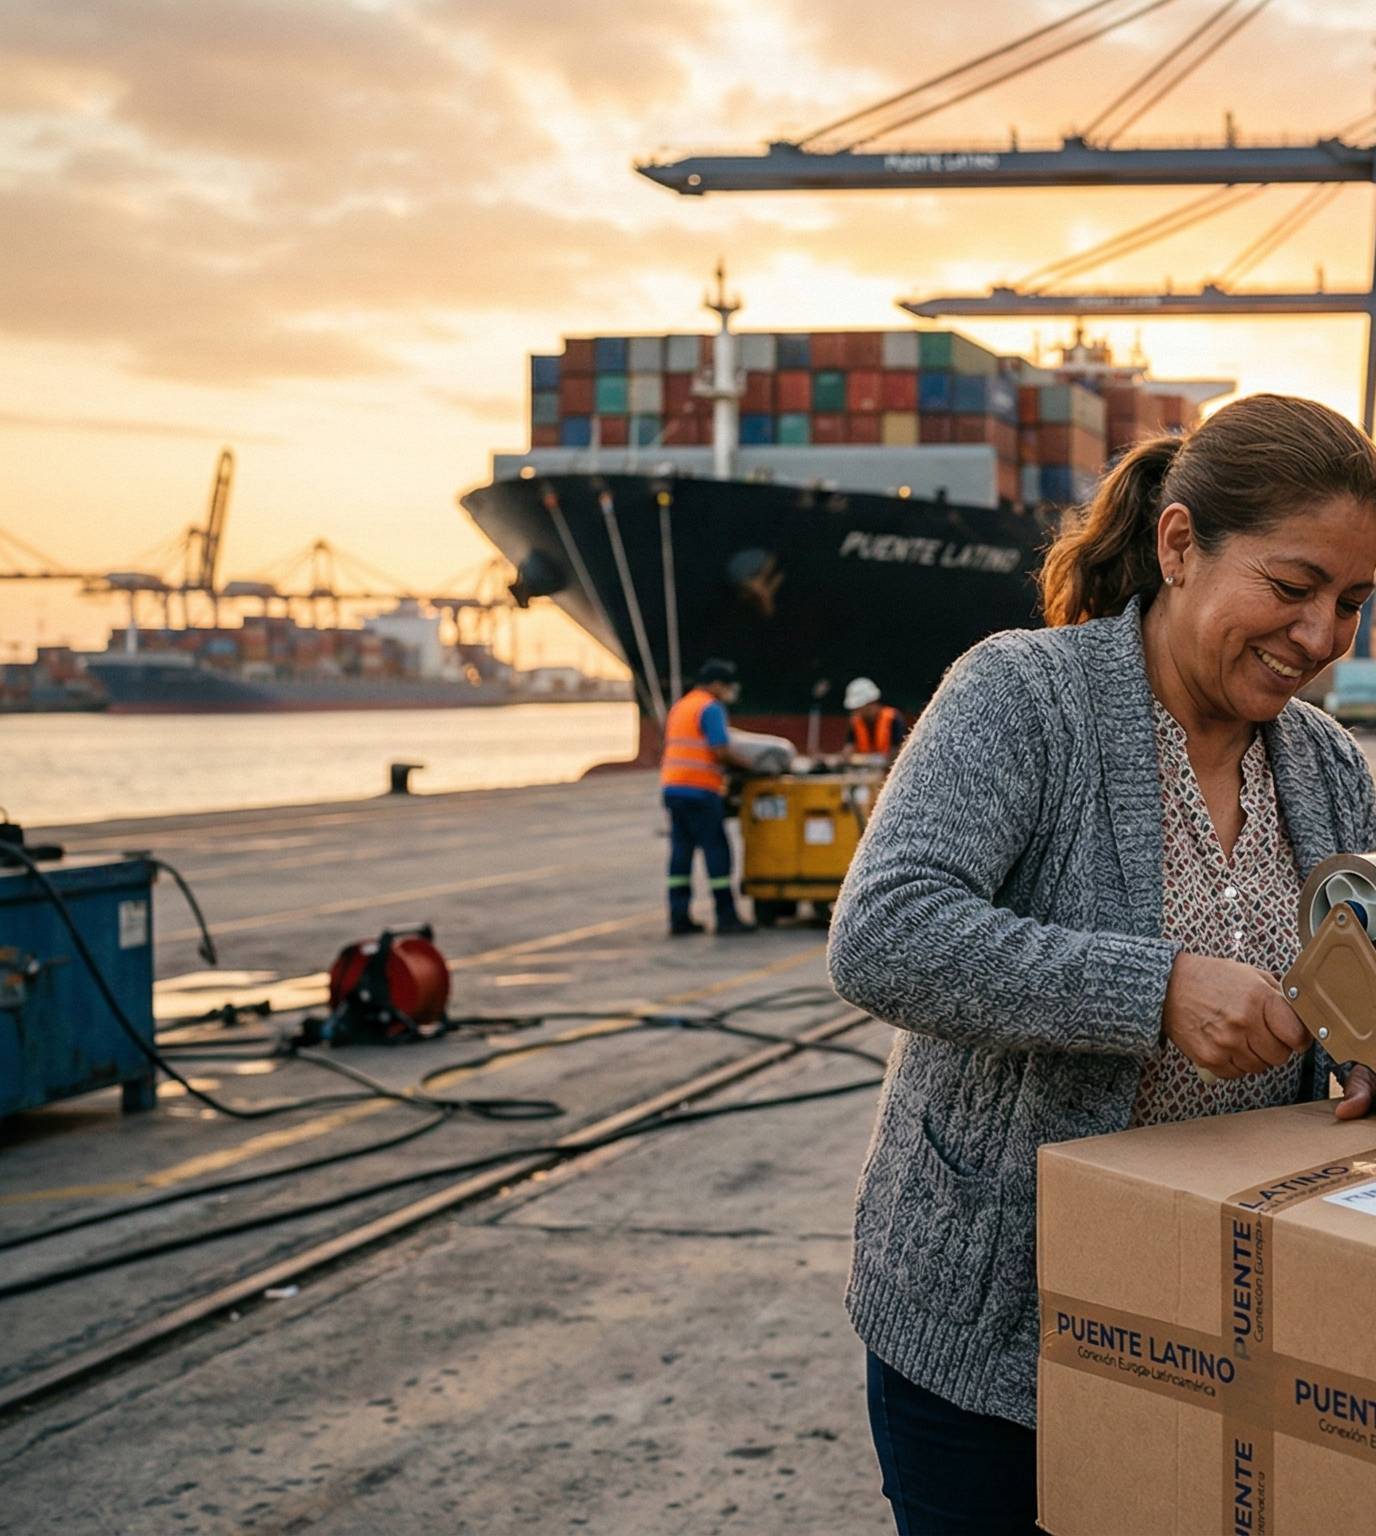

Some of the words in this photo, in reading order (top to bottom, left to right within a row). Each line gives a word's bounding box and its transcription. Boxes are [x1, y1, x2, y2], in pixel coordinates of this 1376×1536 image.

[1238, 1166, 1350, 1210] LATINO
[1233, 1220, 1251, 1361] PUENTE
[1057, 1311, 1142, 1358] PUENTE
[1149, 1337, 1235, 1383] LATINO
